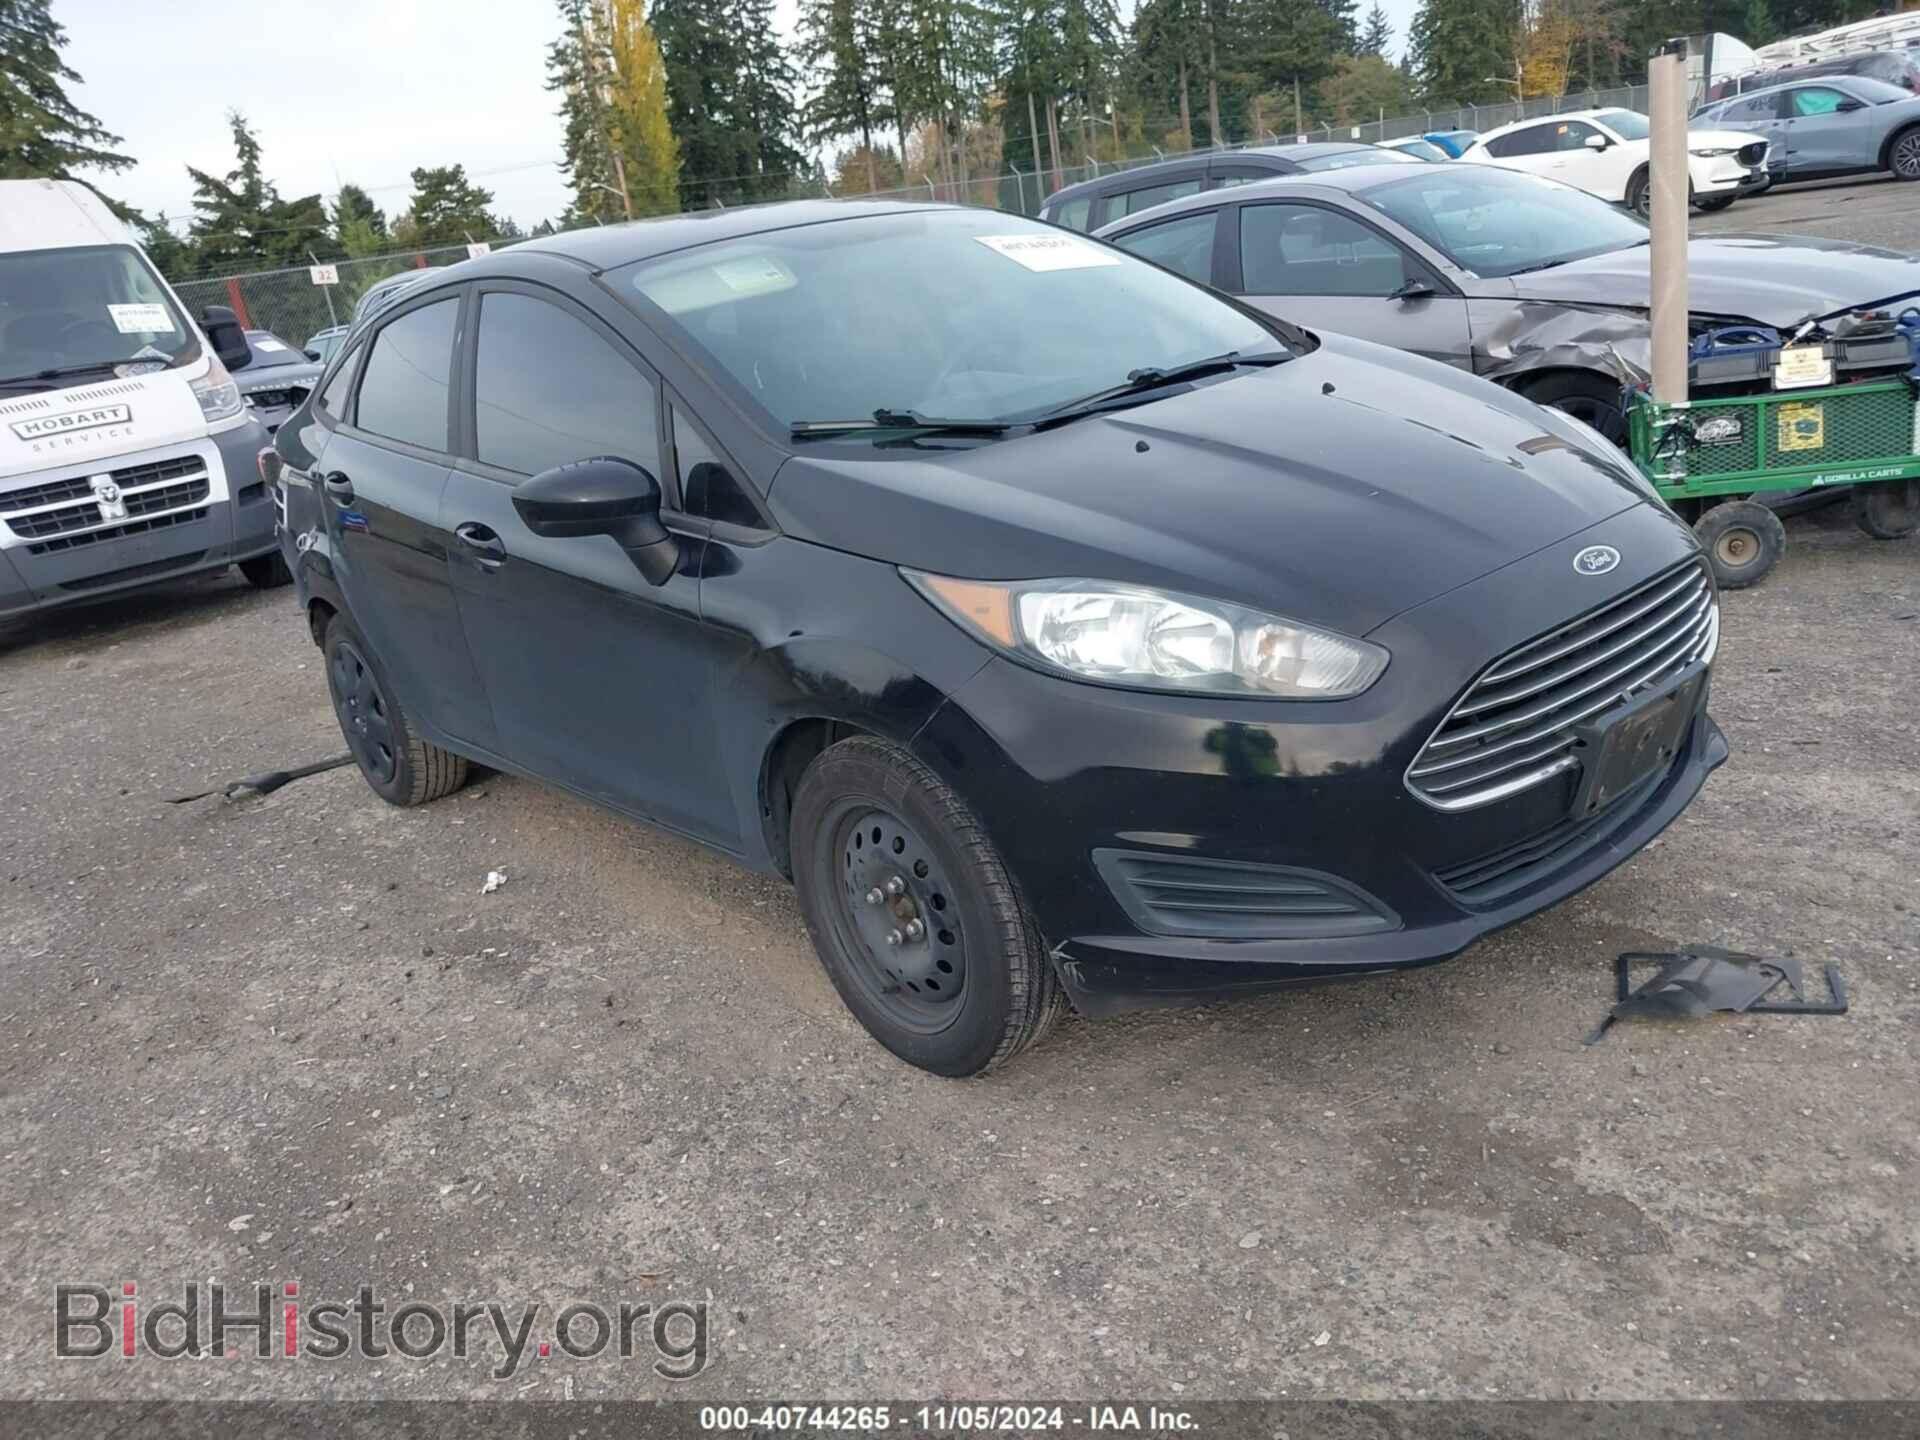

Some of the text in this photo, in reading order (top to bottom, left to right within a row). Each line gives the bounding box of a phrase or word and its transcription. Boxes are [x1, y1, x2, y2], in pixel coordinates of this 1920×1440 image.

[24, 408, 121, 433] HOBART
[32, 427, 135, 453] SERVICE
[1824, 472, 1866, 483] GORILLA
